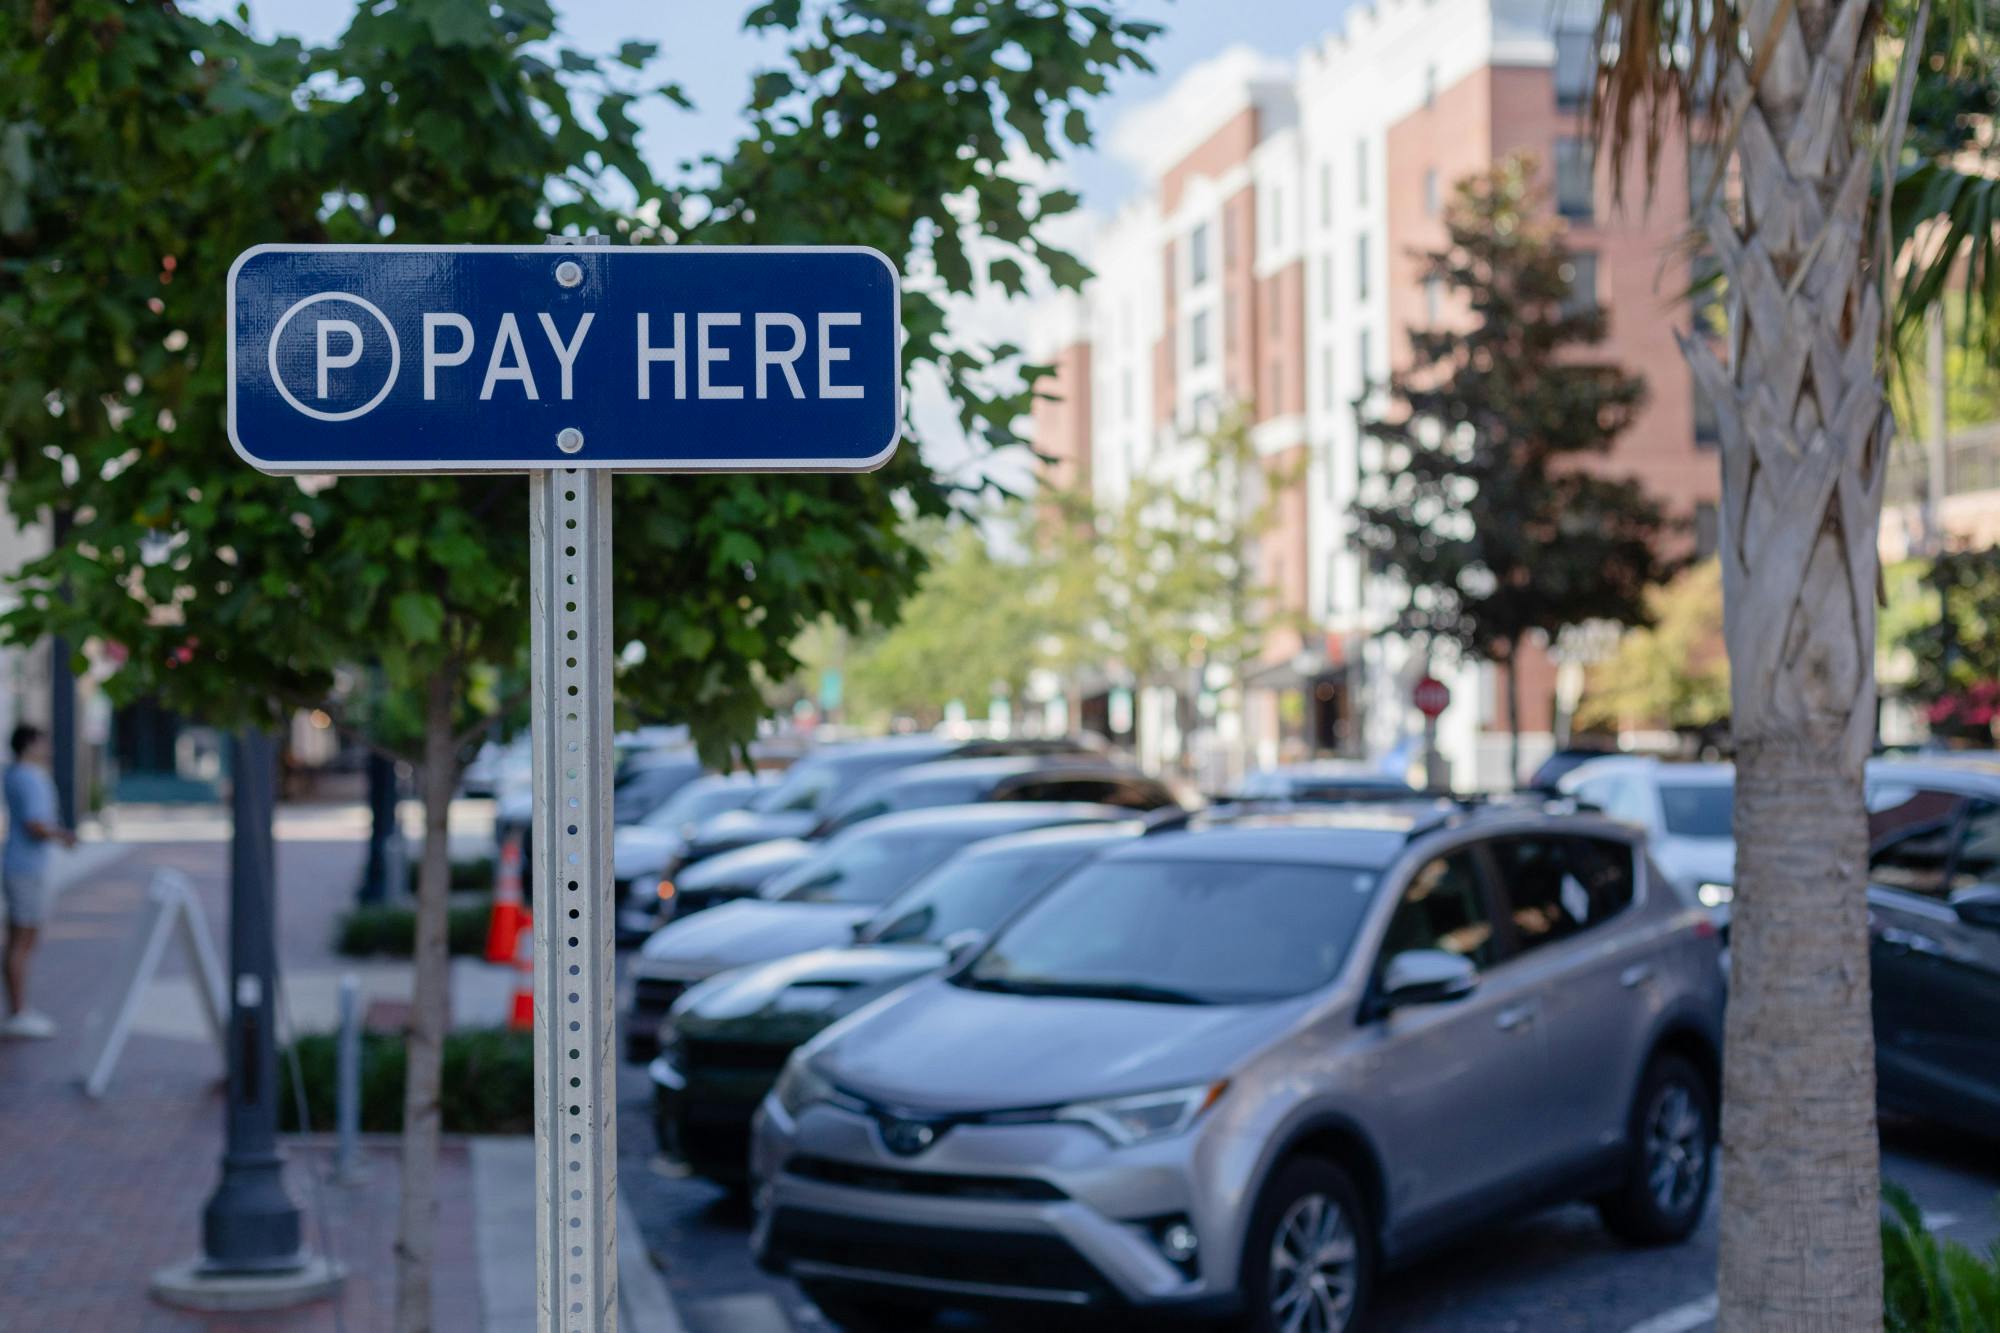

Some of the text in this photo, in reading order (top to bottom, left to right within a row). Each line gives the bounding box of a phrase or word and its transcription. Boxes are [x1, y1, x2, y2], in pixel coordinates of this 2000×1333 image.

[316, 312, 865, 400] P PAY HERE
